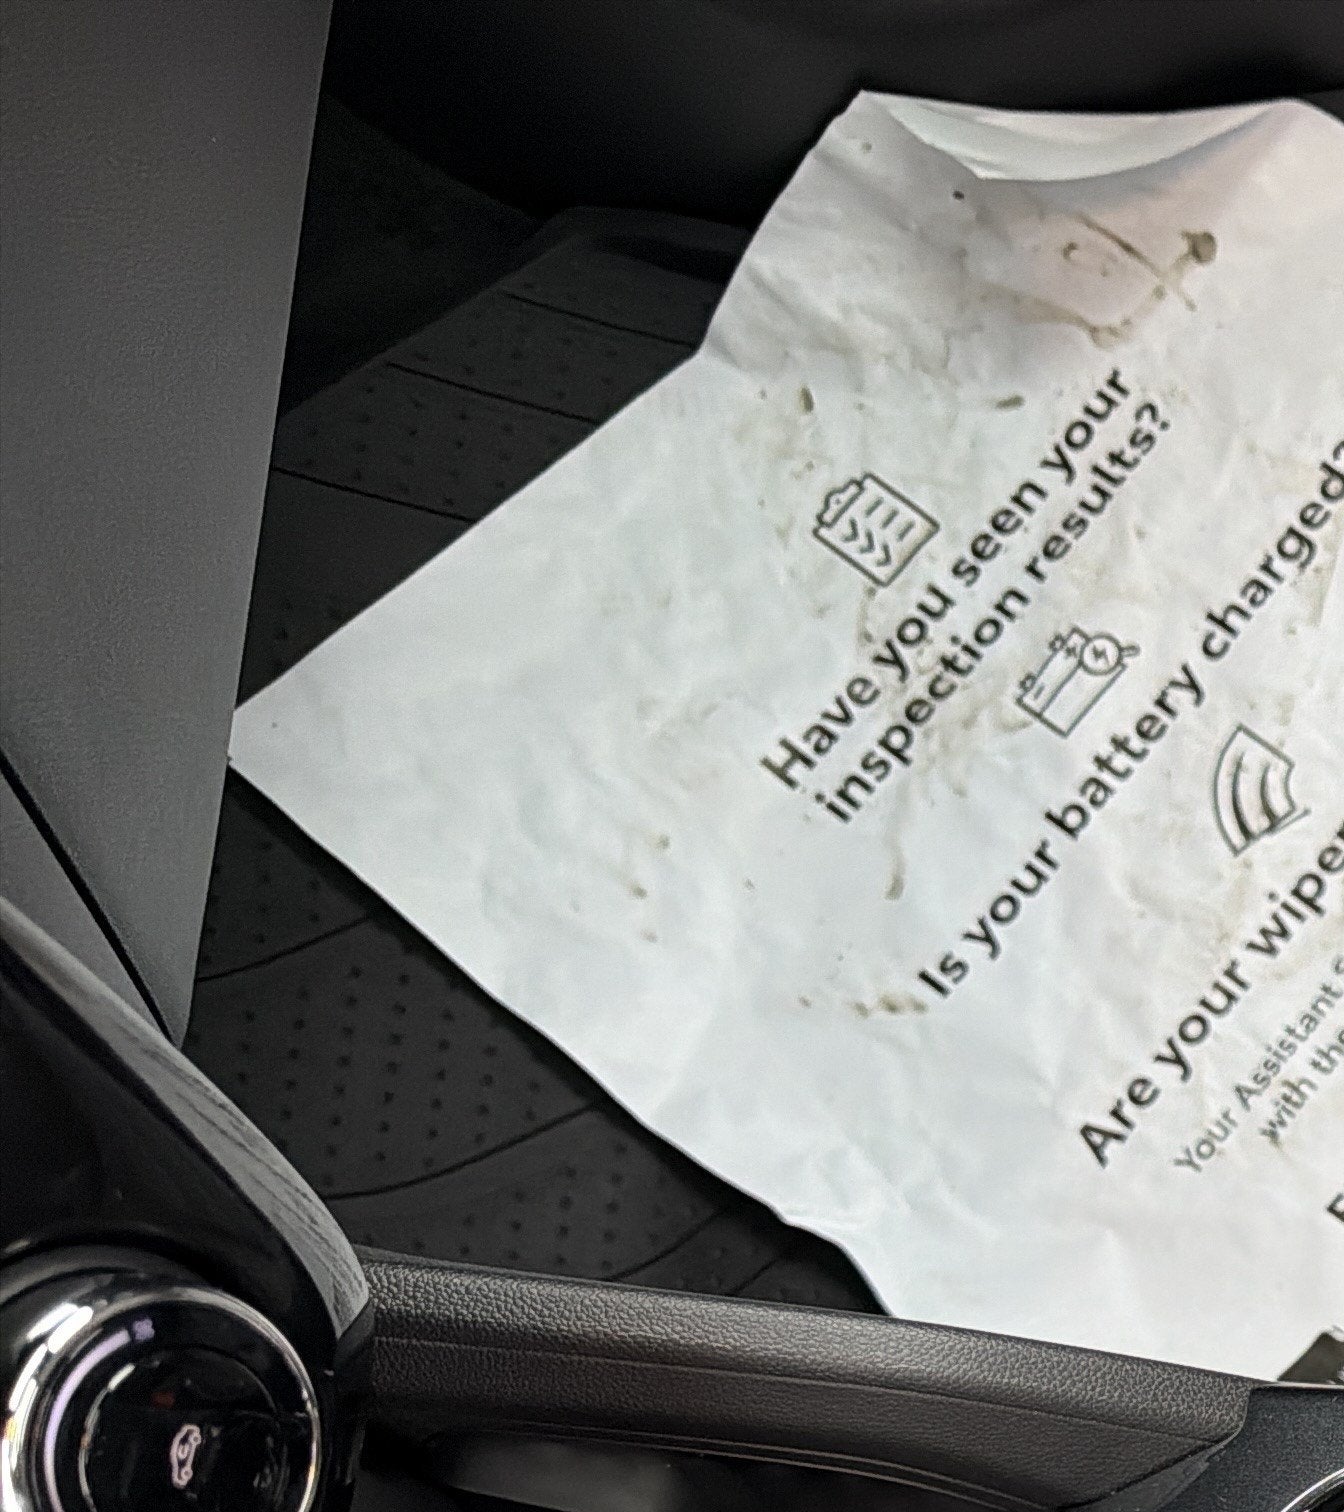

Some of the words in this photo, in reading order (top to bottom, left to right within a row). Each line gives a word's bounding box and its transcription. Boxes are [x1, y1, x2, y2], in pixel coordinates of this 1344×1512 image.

[759, 672, 880, 789] Have
[874, 585, 957, 682] you
[951, 476, 1048, 587] seen
[1040, 368, 1132, 483] your
[815, 589, 1029, 823] inspection
[1025, 402, 1171, 584] results?
[917, 950, 969, 999] Is
[964, 841, 1059, 958] your
[1045, 662, 1207, 839] battery
[1079, 1077, 1161, 1169] Are
[1154, 959, 1251, 1080] your
[1175, 1106, 1239, 1175] Your
[1233, 981, 1341, 1109] Assistant
[1259, 1078, 1314, 1143] with
